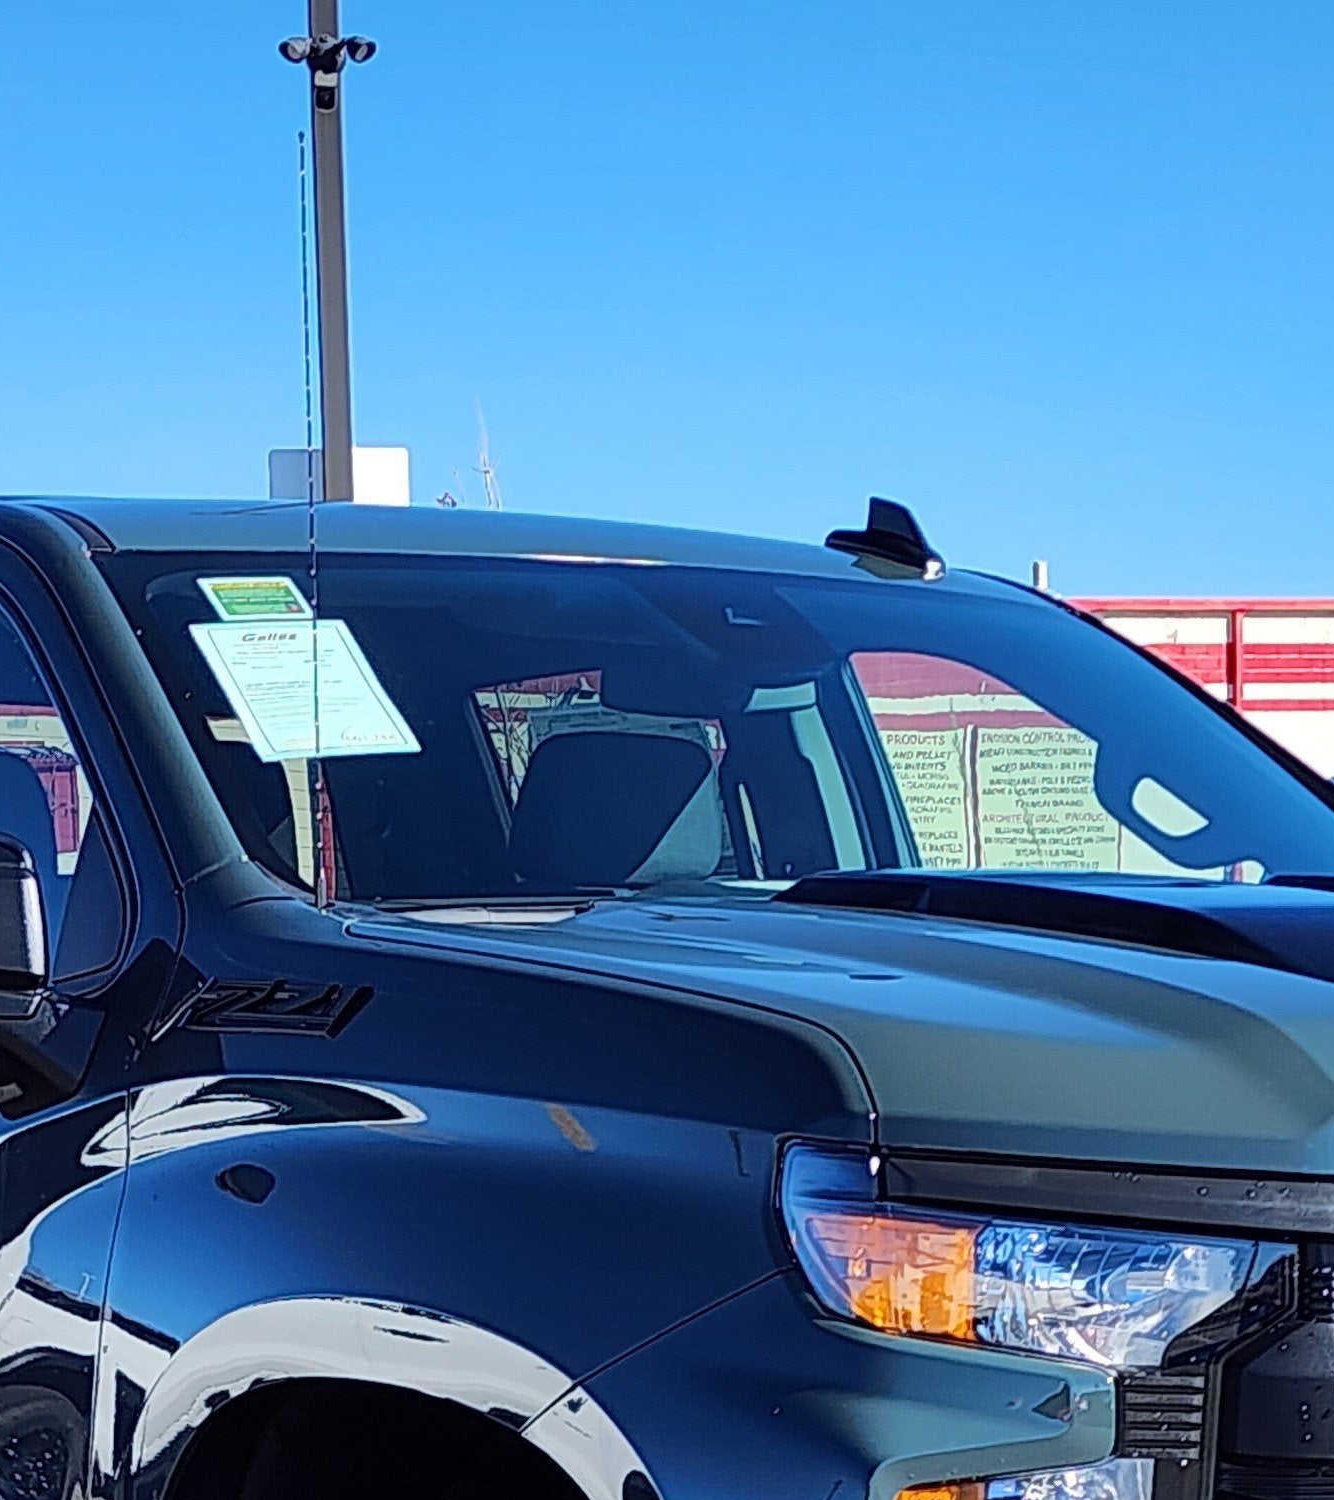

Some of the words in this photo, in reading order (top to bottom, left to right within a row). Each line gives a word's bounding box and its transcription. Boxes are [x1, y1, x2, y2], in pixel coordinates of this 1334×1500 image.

[886, 734, 945, 746] PRODUCTS
[1022, 731, 1065, 744] CONTROL
[1067, 733, 1091, 744] PRO
